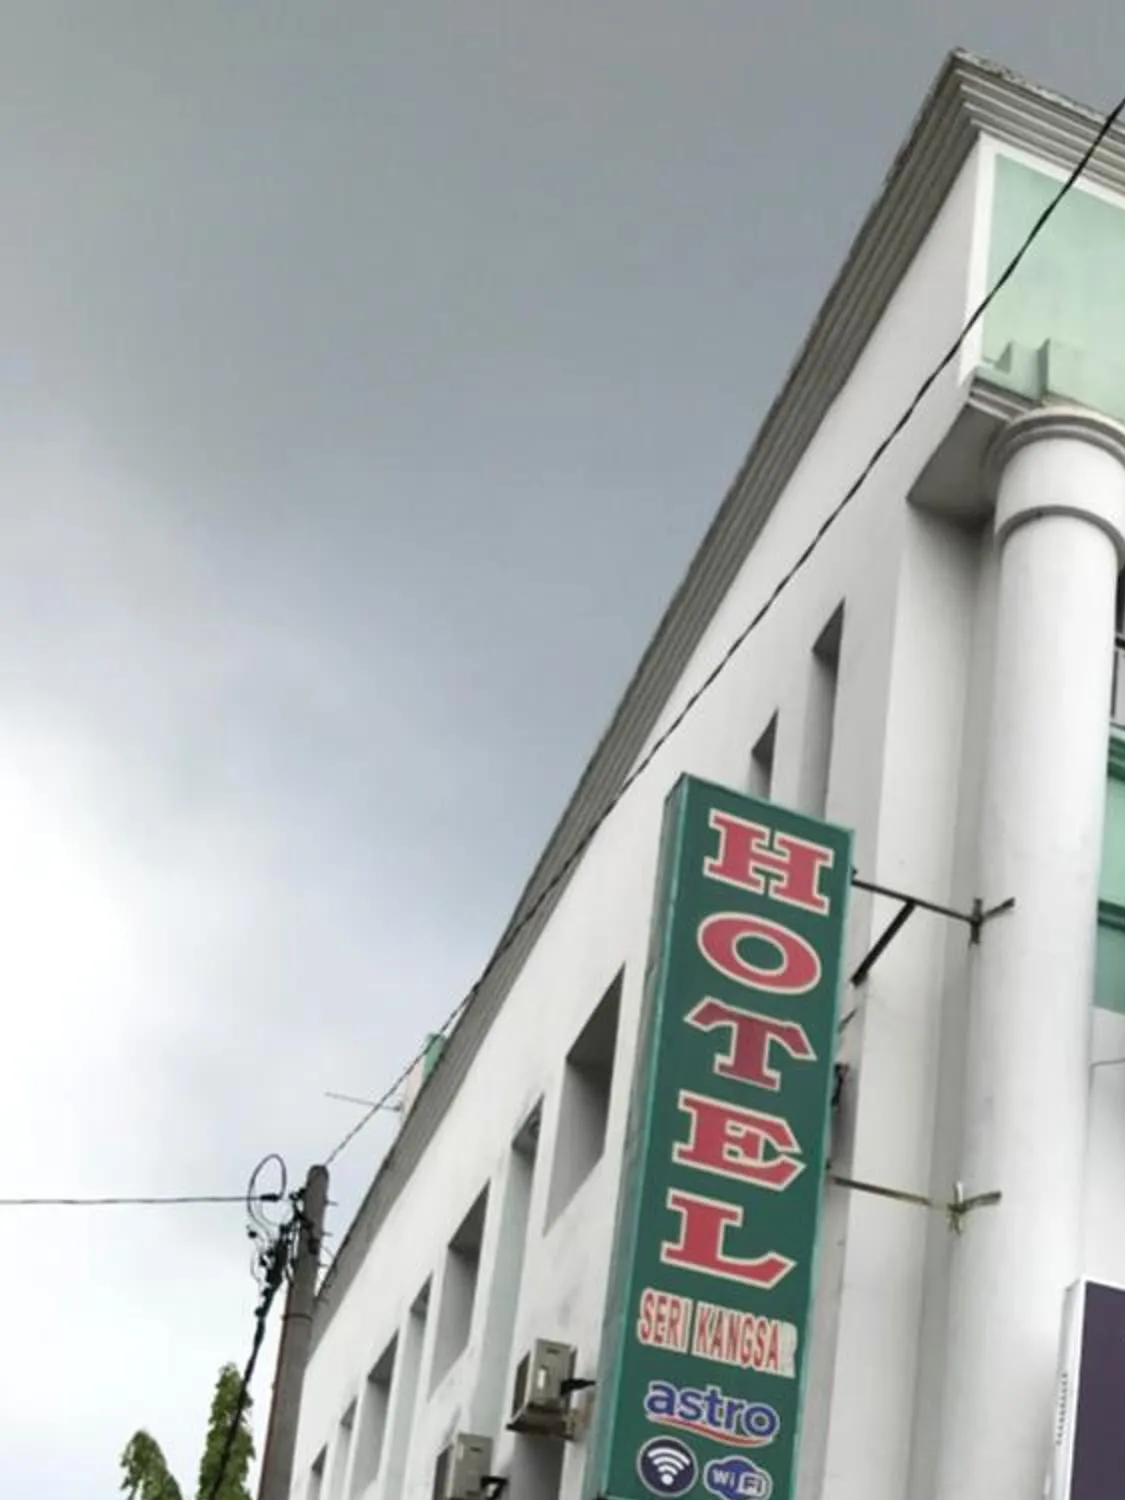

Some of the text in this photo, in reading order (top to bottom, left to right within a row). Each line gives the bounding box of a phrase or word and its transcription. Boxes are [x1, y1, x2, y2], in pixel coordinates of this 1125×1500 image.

[660, 810, 833, 1288] HOTEL
[637, 1288, 693, 1353] SERI
[644, 1380, 780, 1440] astro
